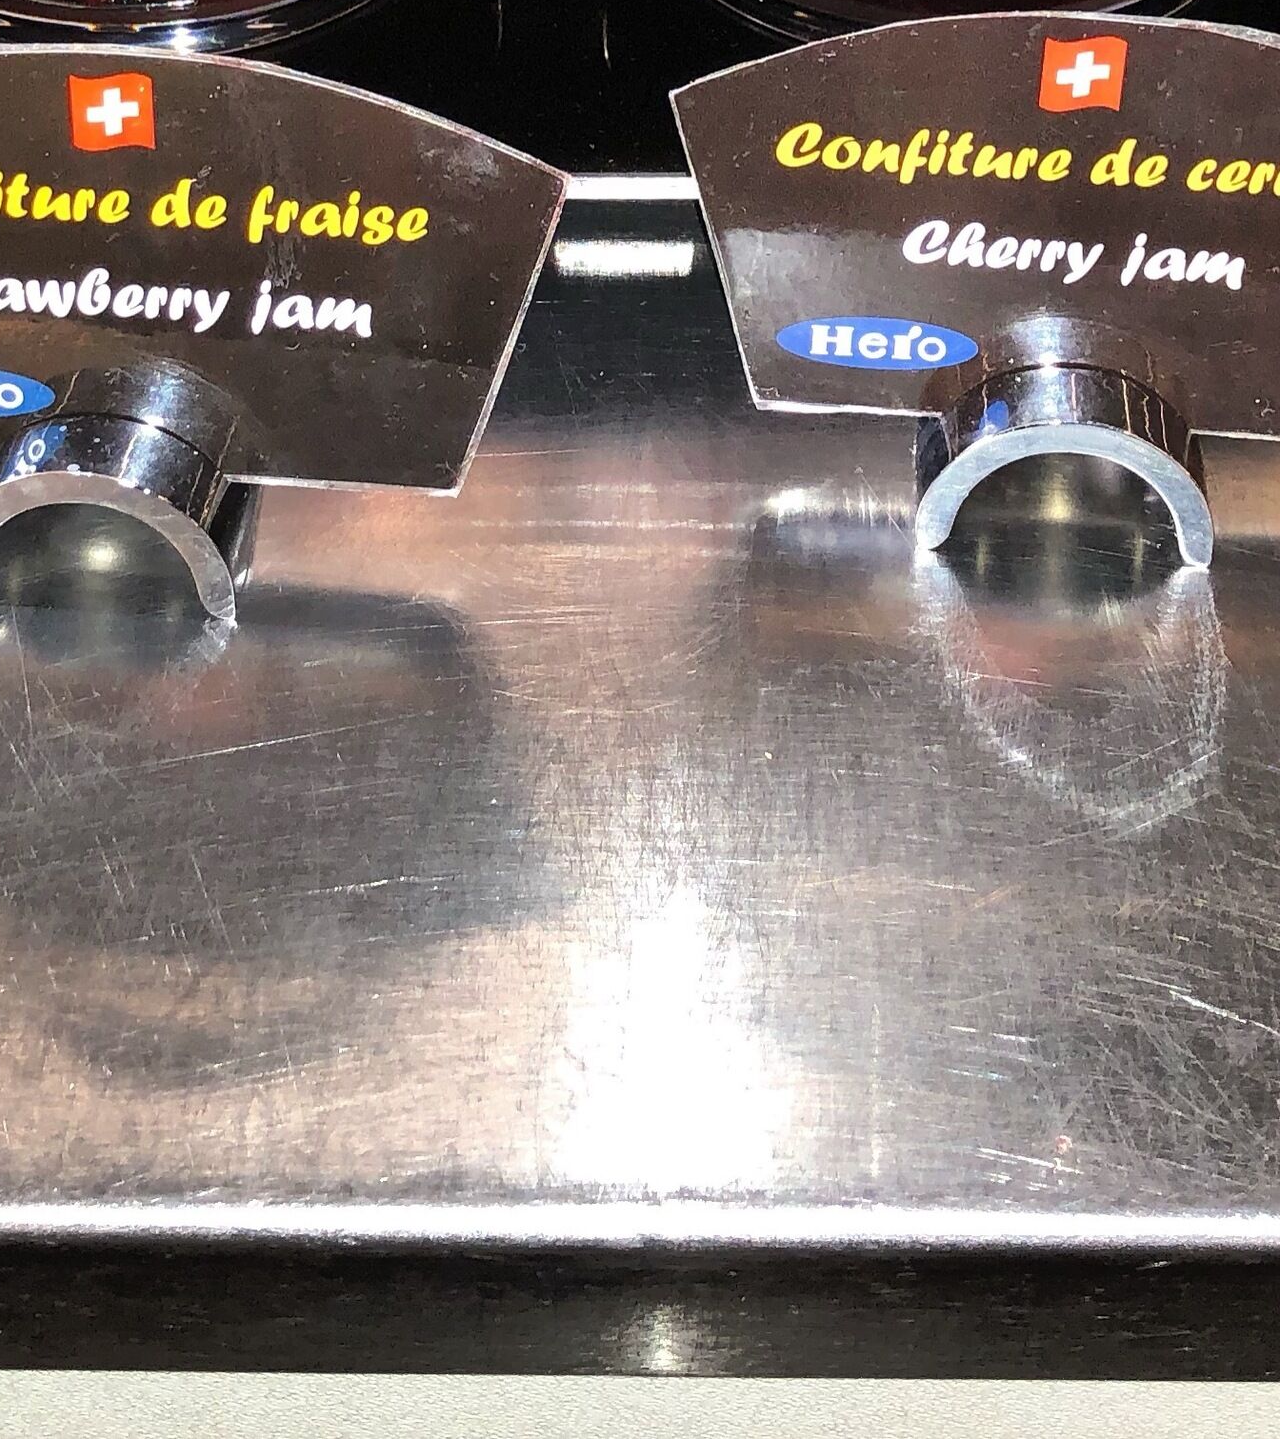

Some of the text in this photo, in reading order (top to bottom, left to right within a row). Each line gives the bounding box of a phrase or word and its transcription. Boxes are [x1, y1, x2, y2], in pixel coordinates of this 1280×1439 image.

[775, 122, 1072, 185] Confiture
[1089, 138, 1169, 188] de
[150, 178, 227, 229] de
[248, 185, 429, 246] fraise
[901, 219, 1245, 291] Cherry jam
[250, 279, 372, 338] jam
[809, 323, 947, 363] Hero
